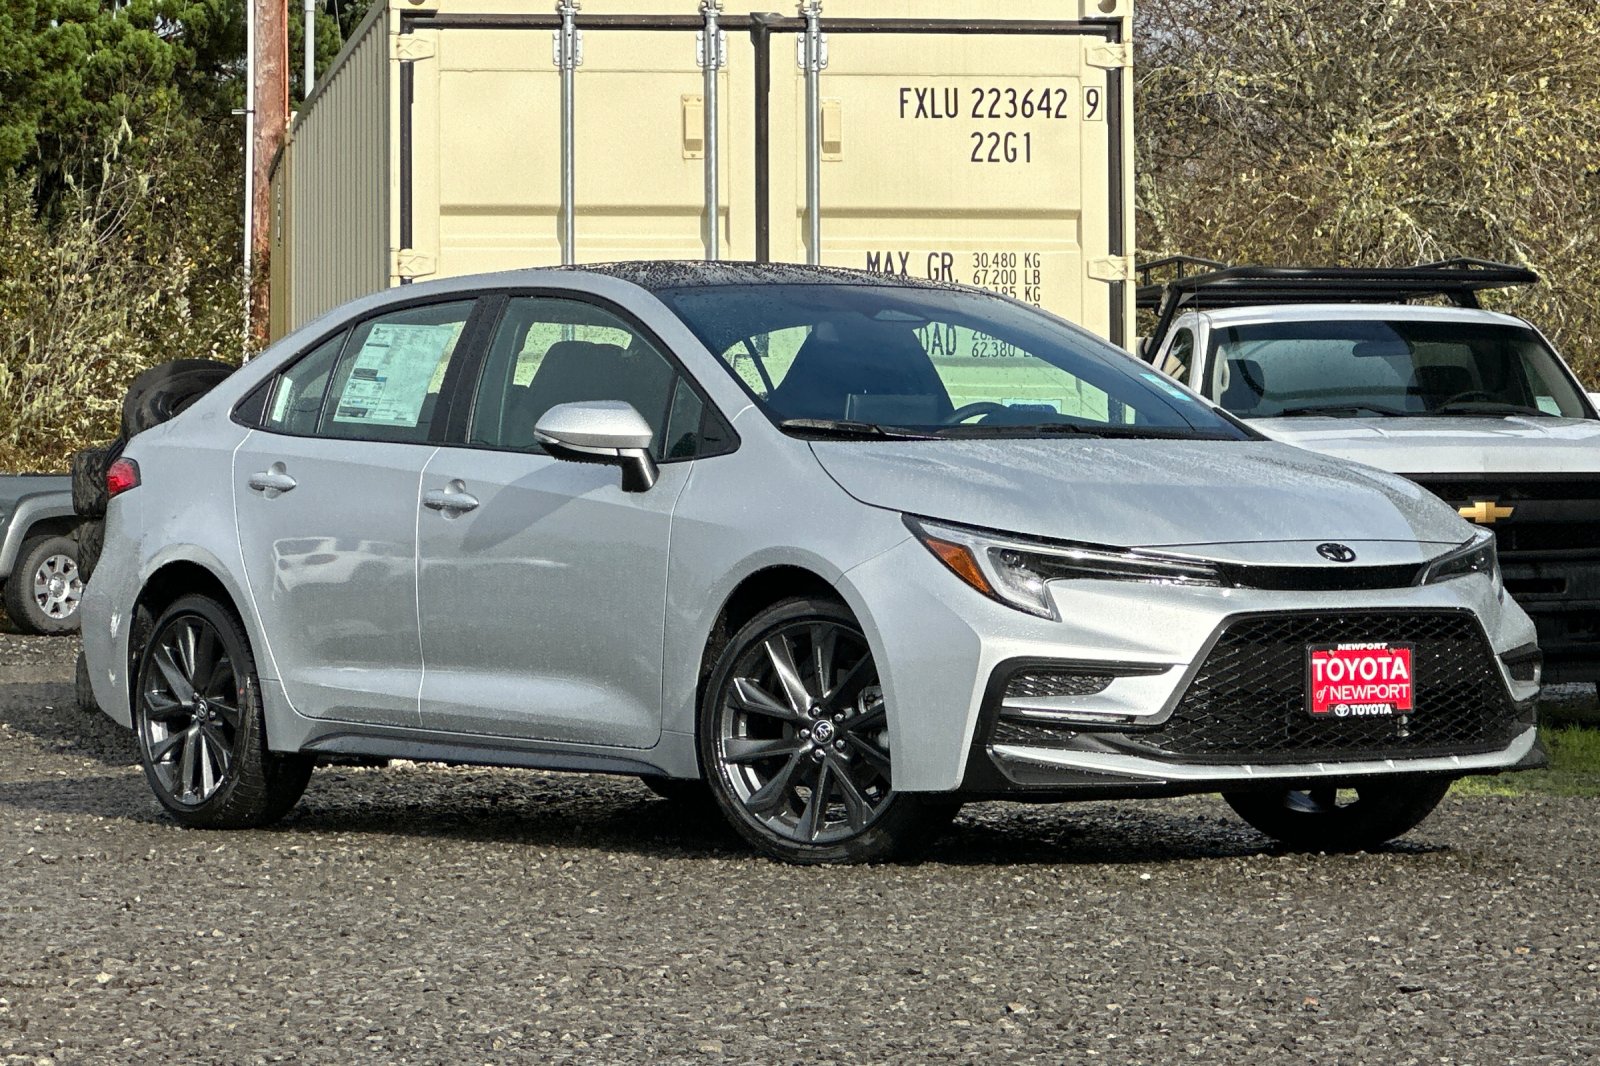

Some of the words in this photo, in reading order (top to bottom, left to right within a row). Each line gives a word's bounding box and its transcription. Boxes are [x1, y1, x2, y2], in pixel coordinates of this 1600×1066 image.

[899, 87, 958, 119] FXLU
[971, 88, 1068, 119] 223642
[1086, 88, 1099, 118] 9
[970, 132, 1031, 163] 22G1
[866, 251, 910, 276] MAX
[927, 252, 959, 283] GR.
[1024, 252, 1041, 268] KG
[1024, 269, 1041, 285] LB
[1024, 286, 1041, 302] KG
[1337, 643, 1388, 651] NEWPORT
[1312, 657, 1409, 682] TOYOTA
[1316, 685, 1329, 703] of
[1330, 684, 1410, 700] NEWPORT
[1350, 704, 1392, 715] TOYOTA
